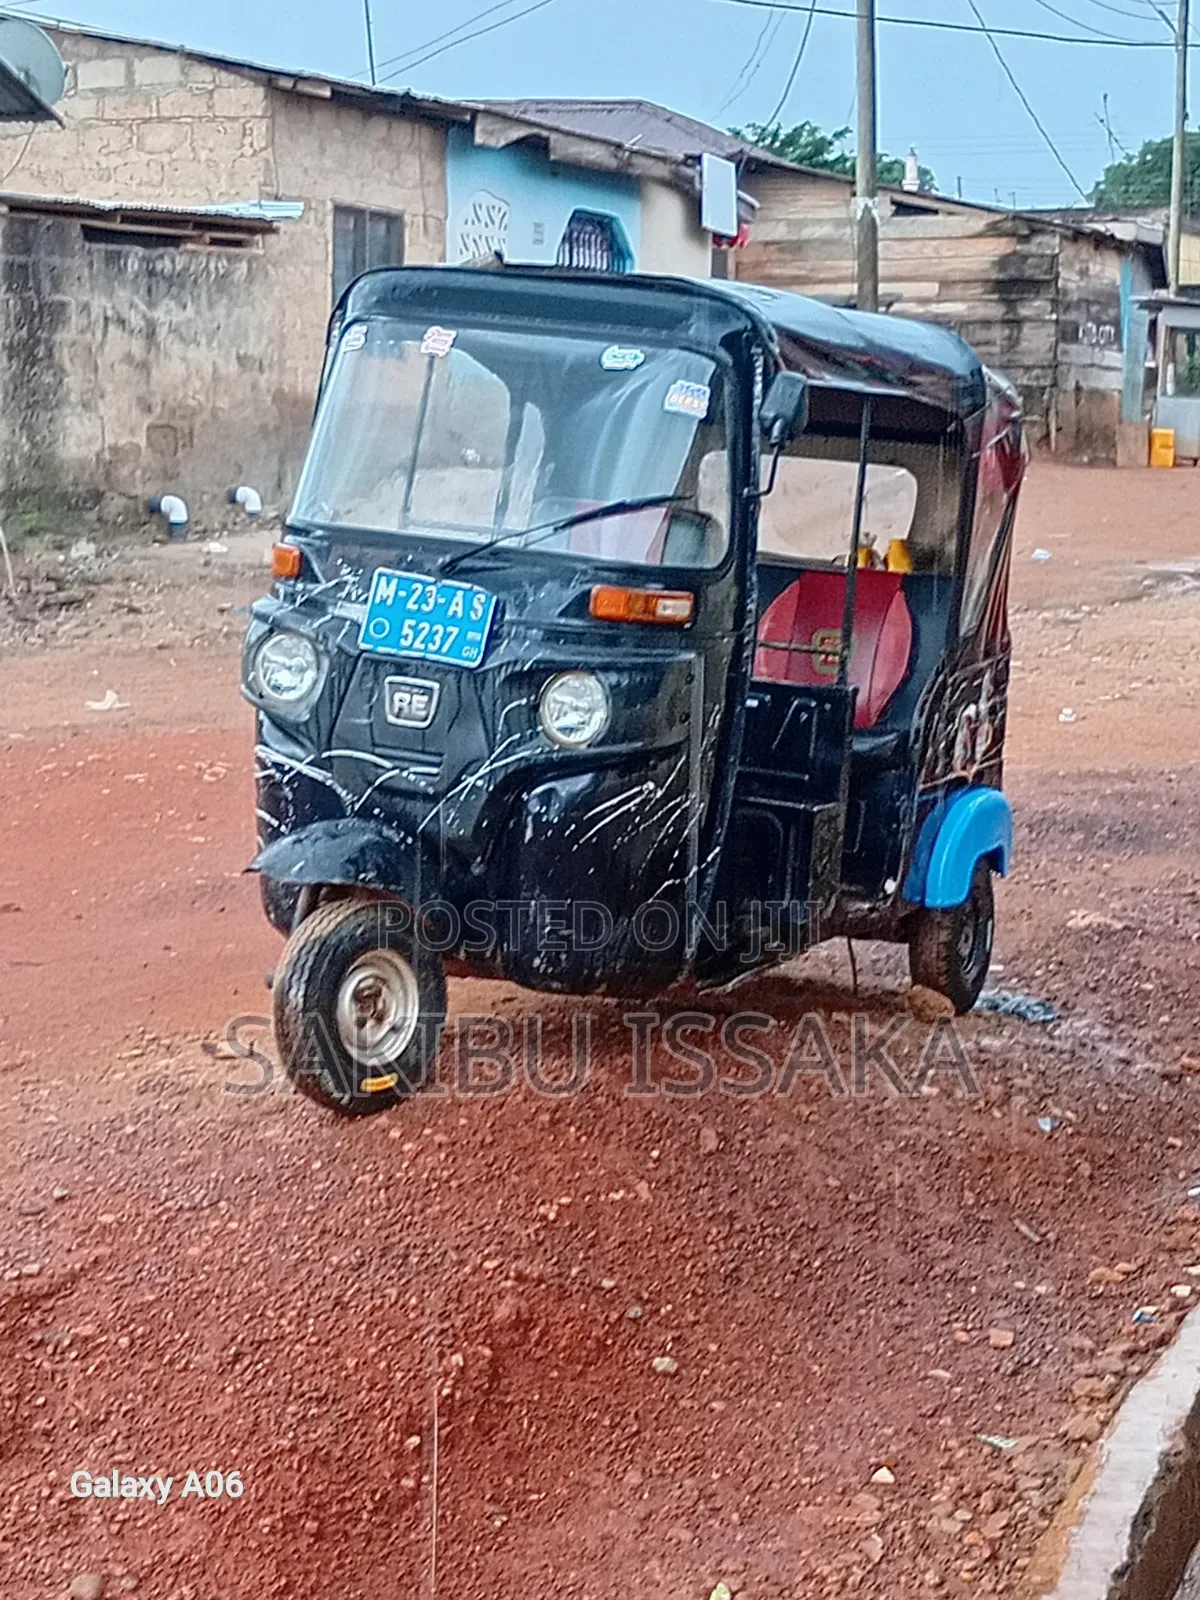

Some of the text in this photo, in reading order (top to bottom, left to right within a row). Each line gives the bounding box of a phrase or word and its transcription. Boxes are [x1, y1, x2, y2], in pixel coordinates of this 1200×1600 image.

[400, 618, 460, 654] 5237
[461, 645, 479, 659] GH
[393, 691, 429, 717] RE
